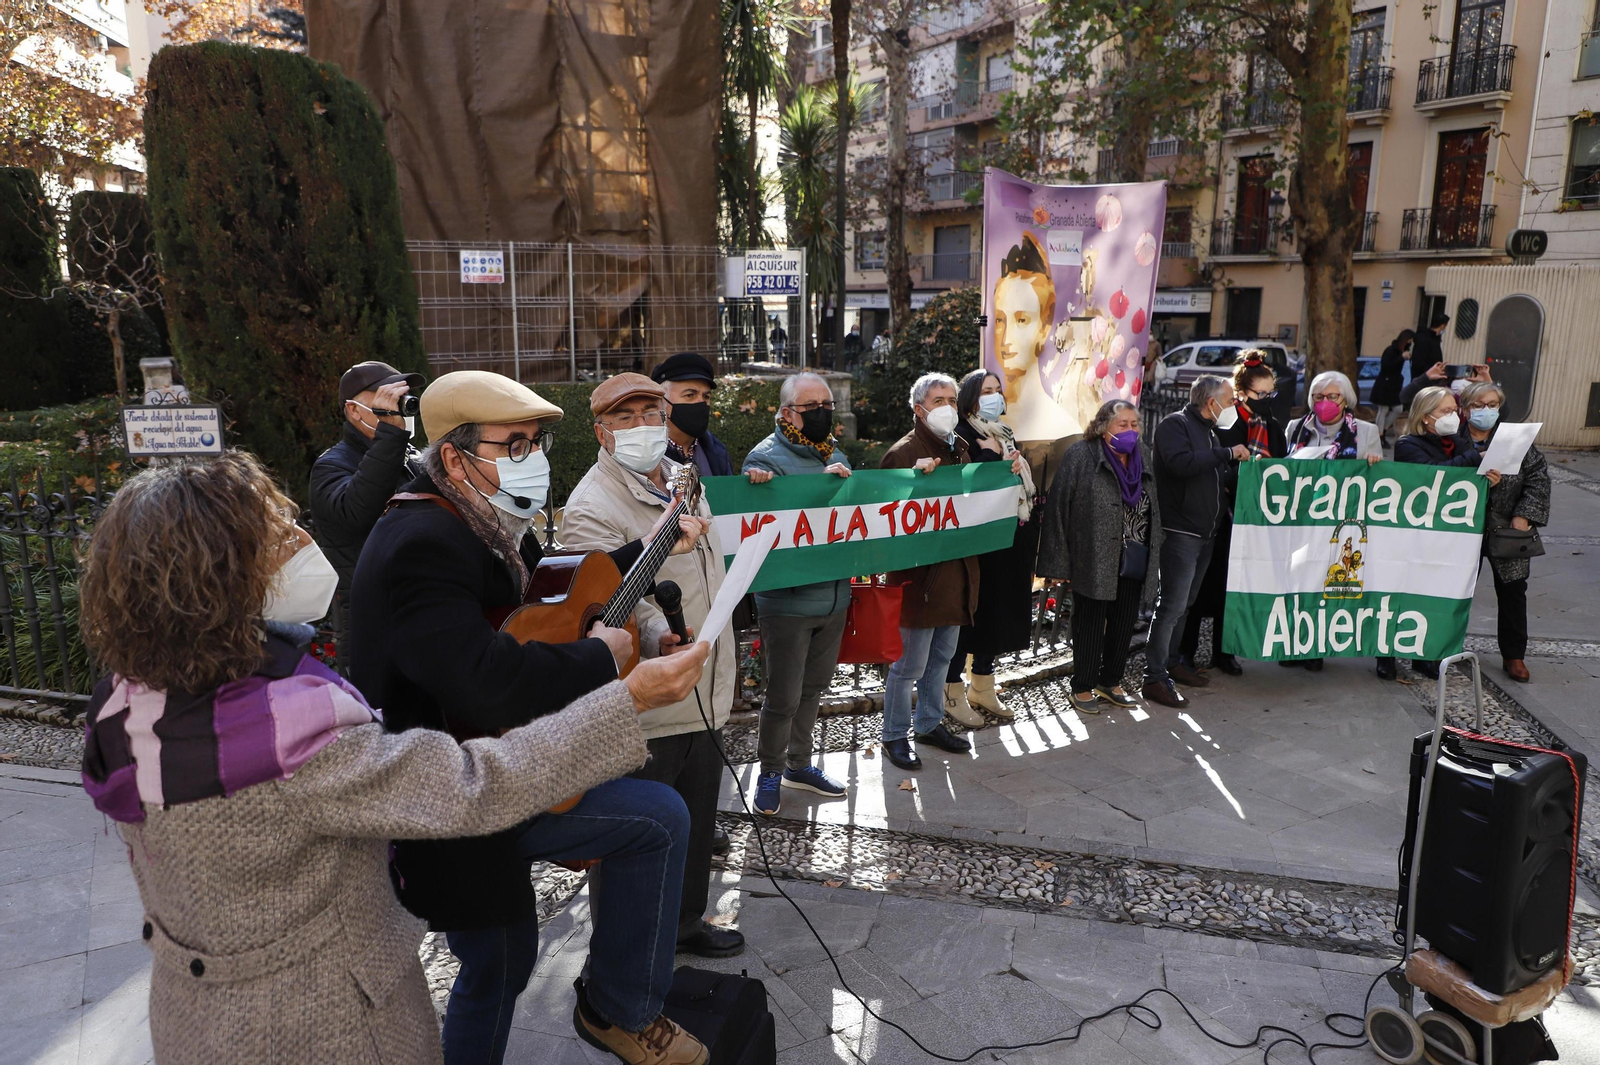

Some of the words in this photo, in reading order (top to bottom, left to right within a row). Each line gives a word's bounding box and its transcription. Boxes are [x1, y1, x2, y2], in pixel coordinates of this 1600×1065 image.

[1049, 213, 1074, 227] Granada
[1075, 213, 1096, 227] Abierta
[1520, 235, 1540, 252] WC
[747, 276, 763, 288] 958
[764, 276, 775, 288] 42
[776, 276, 786, 288] 01
[788, 276, 799, 288] 45
[126, 411, 149, 422] Fuente
[151, 410, 173, 422] dotada
[175, 410, 182, 420] de
[184, 410, 208, 421] sistema
[209, 410, 217, 420] de
[143, 423, 173, 436] reciclaje
[175, 422, 185, 433] del
[185, 426, 203, 435] agua
[1259, 463, 1479, 528] Granada
[793, 510, 814, 548] A
[827, 505, 868, 544] LA
[879, 496, 960, 537] TOMA
[1262, 594, 1428, 657] Abierta
